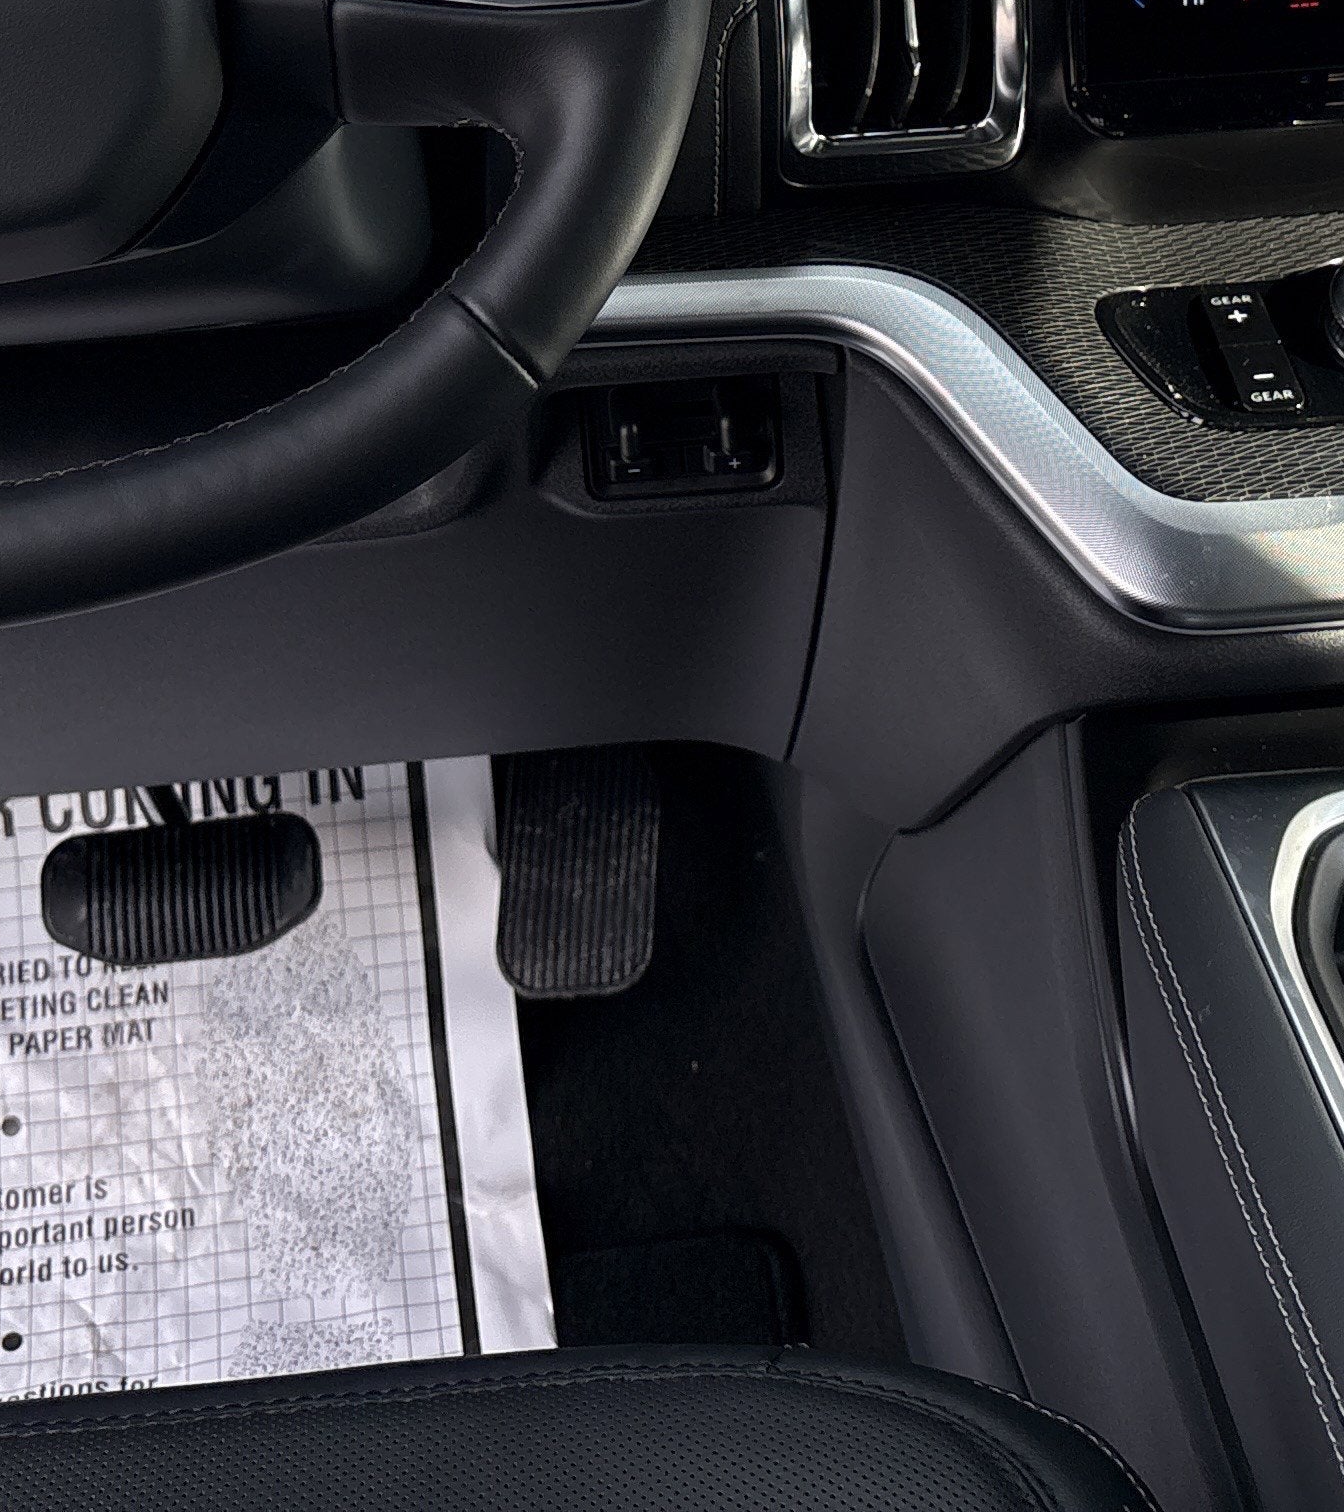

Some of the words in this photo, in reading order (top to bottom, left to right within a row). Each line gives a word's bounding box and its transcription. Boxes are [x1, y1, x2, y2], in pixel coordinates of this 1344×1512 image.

[1209, 291, 1254, 307] GEAR
[1249, 387, 1296, 404] GEAR
[58, 954, 93, 981] TO
[86, 980, 171, 1012] CLEAN
[8, 1025, 92, 1056] PAPER
[101, 1016, 159, 1046] MAT
[102, 1206, 197, 1242] person
[61, 1255, 89, 1280] to
[97, 1250, 140, 1275] us.
